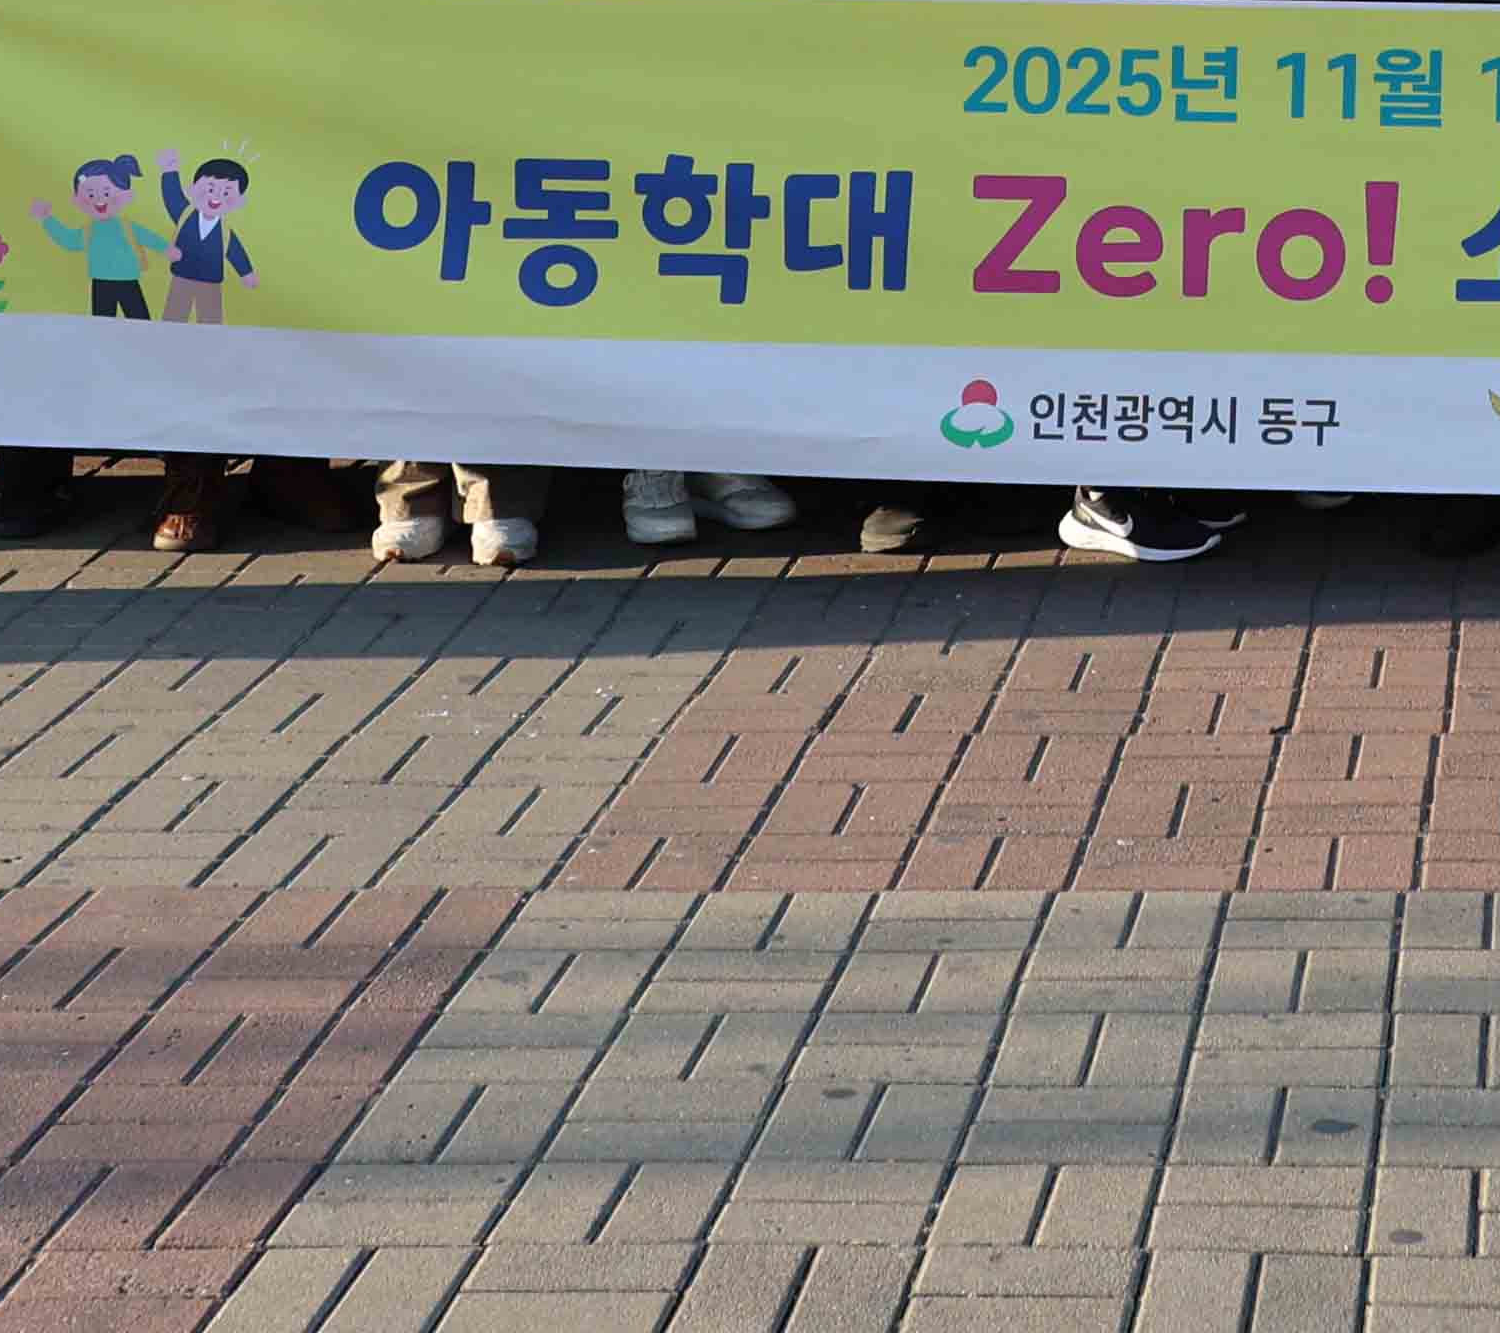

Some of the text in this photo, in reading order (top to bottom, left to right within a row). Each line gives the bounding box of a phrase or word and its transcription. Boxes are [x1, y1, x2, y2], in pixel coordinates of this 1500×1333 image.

[964, 45, 1241, 127] 2025년
[1277, 48, 1447, 130] 11월
[353, 153, 913, 310] 아동학대
[970, 171, 1398, 304] Zero!
[1028, 391, 1341, 447] 인천광역시 동구
